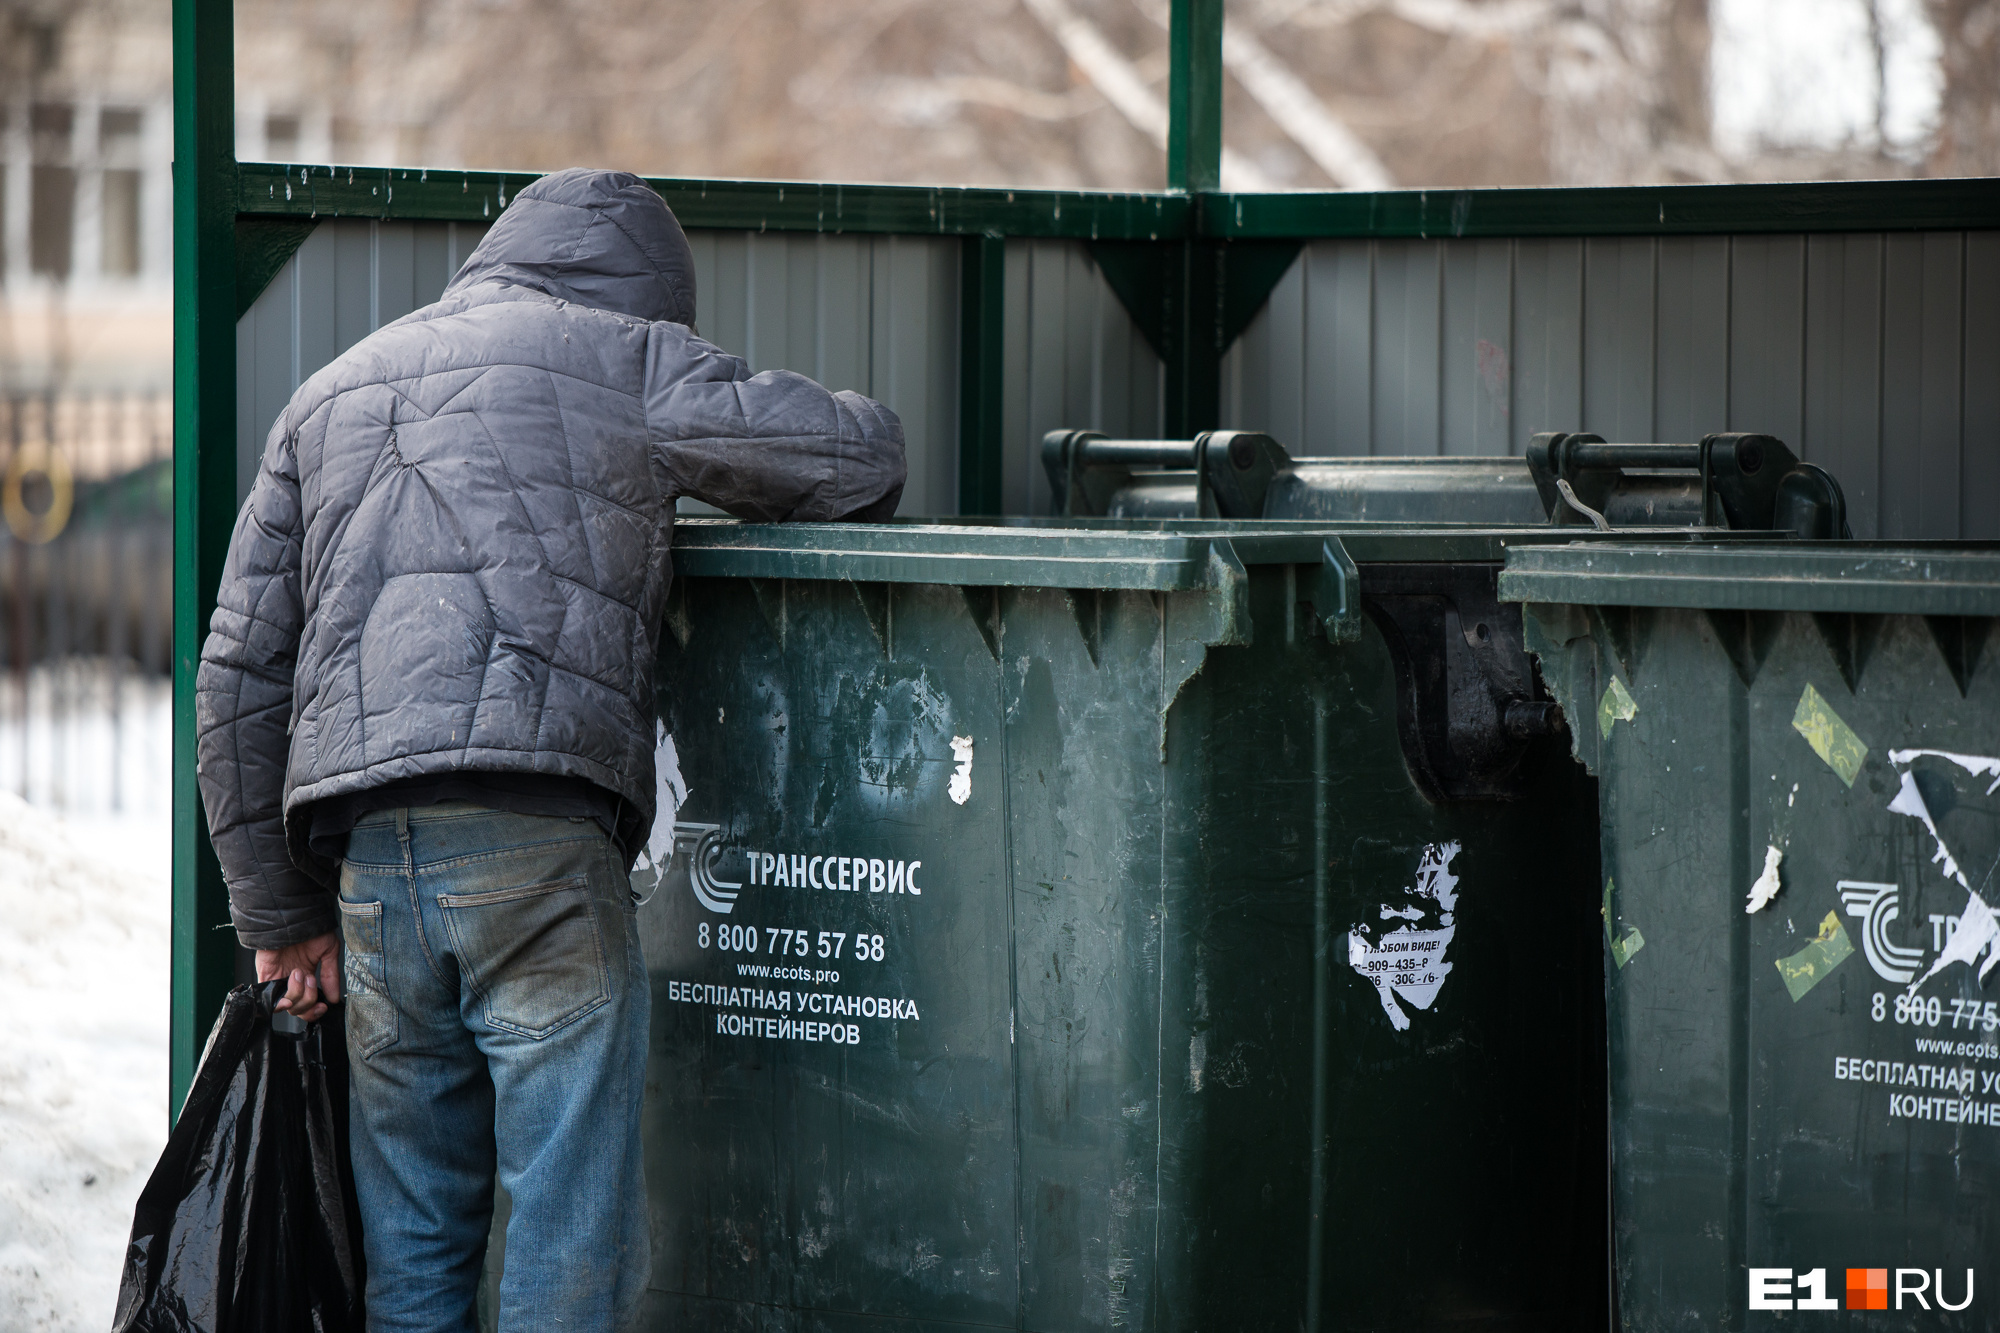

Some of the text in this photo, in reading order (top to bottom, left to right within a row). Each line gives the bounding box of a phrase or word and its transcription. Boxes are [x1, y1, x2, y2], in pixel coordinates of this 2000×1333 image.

[747, 851, 922, 895] ТРАНССЕРВИС
[698, 922, 885, 962] 8 800 775 57 58
[1411, 941, 1440, 952] ВИДЕ!
[737, 963, 840, 984] www.ecots.pro
[668, 980, 920, 1021] БЕСПЛАТНАЯ УСТАНОВКА
[1871, 992, 1998, 1032] 8 800 775
[716, 1013, 860, 1045] КОНТЕЙНЕРОВ
[1835, 1056, 1975, 1093] БЕСПЛАТНАЯ
[1889, 1093, 2000, 1127] КОНТЕЙНЕ
